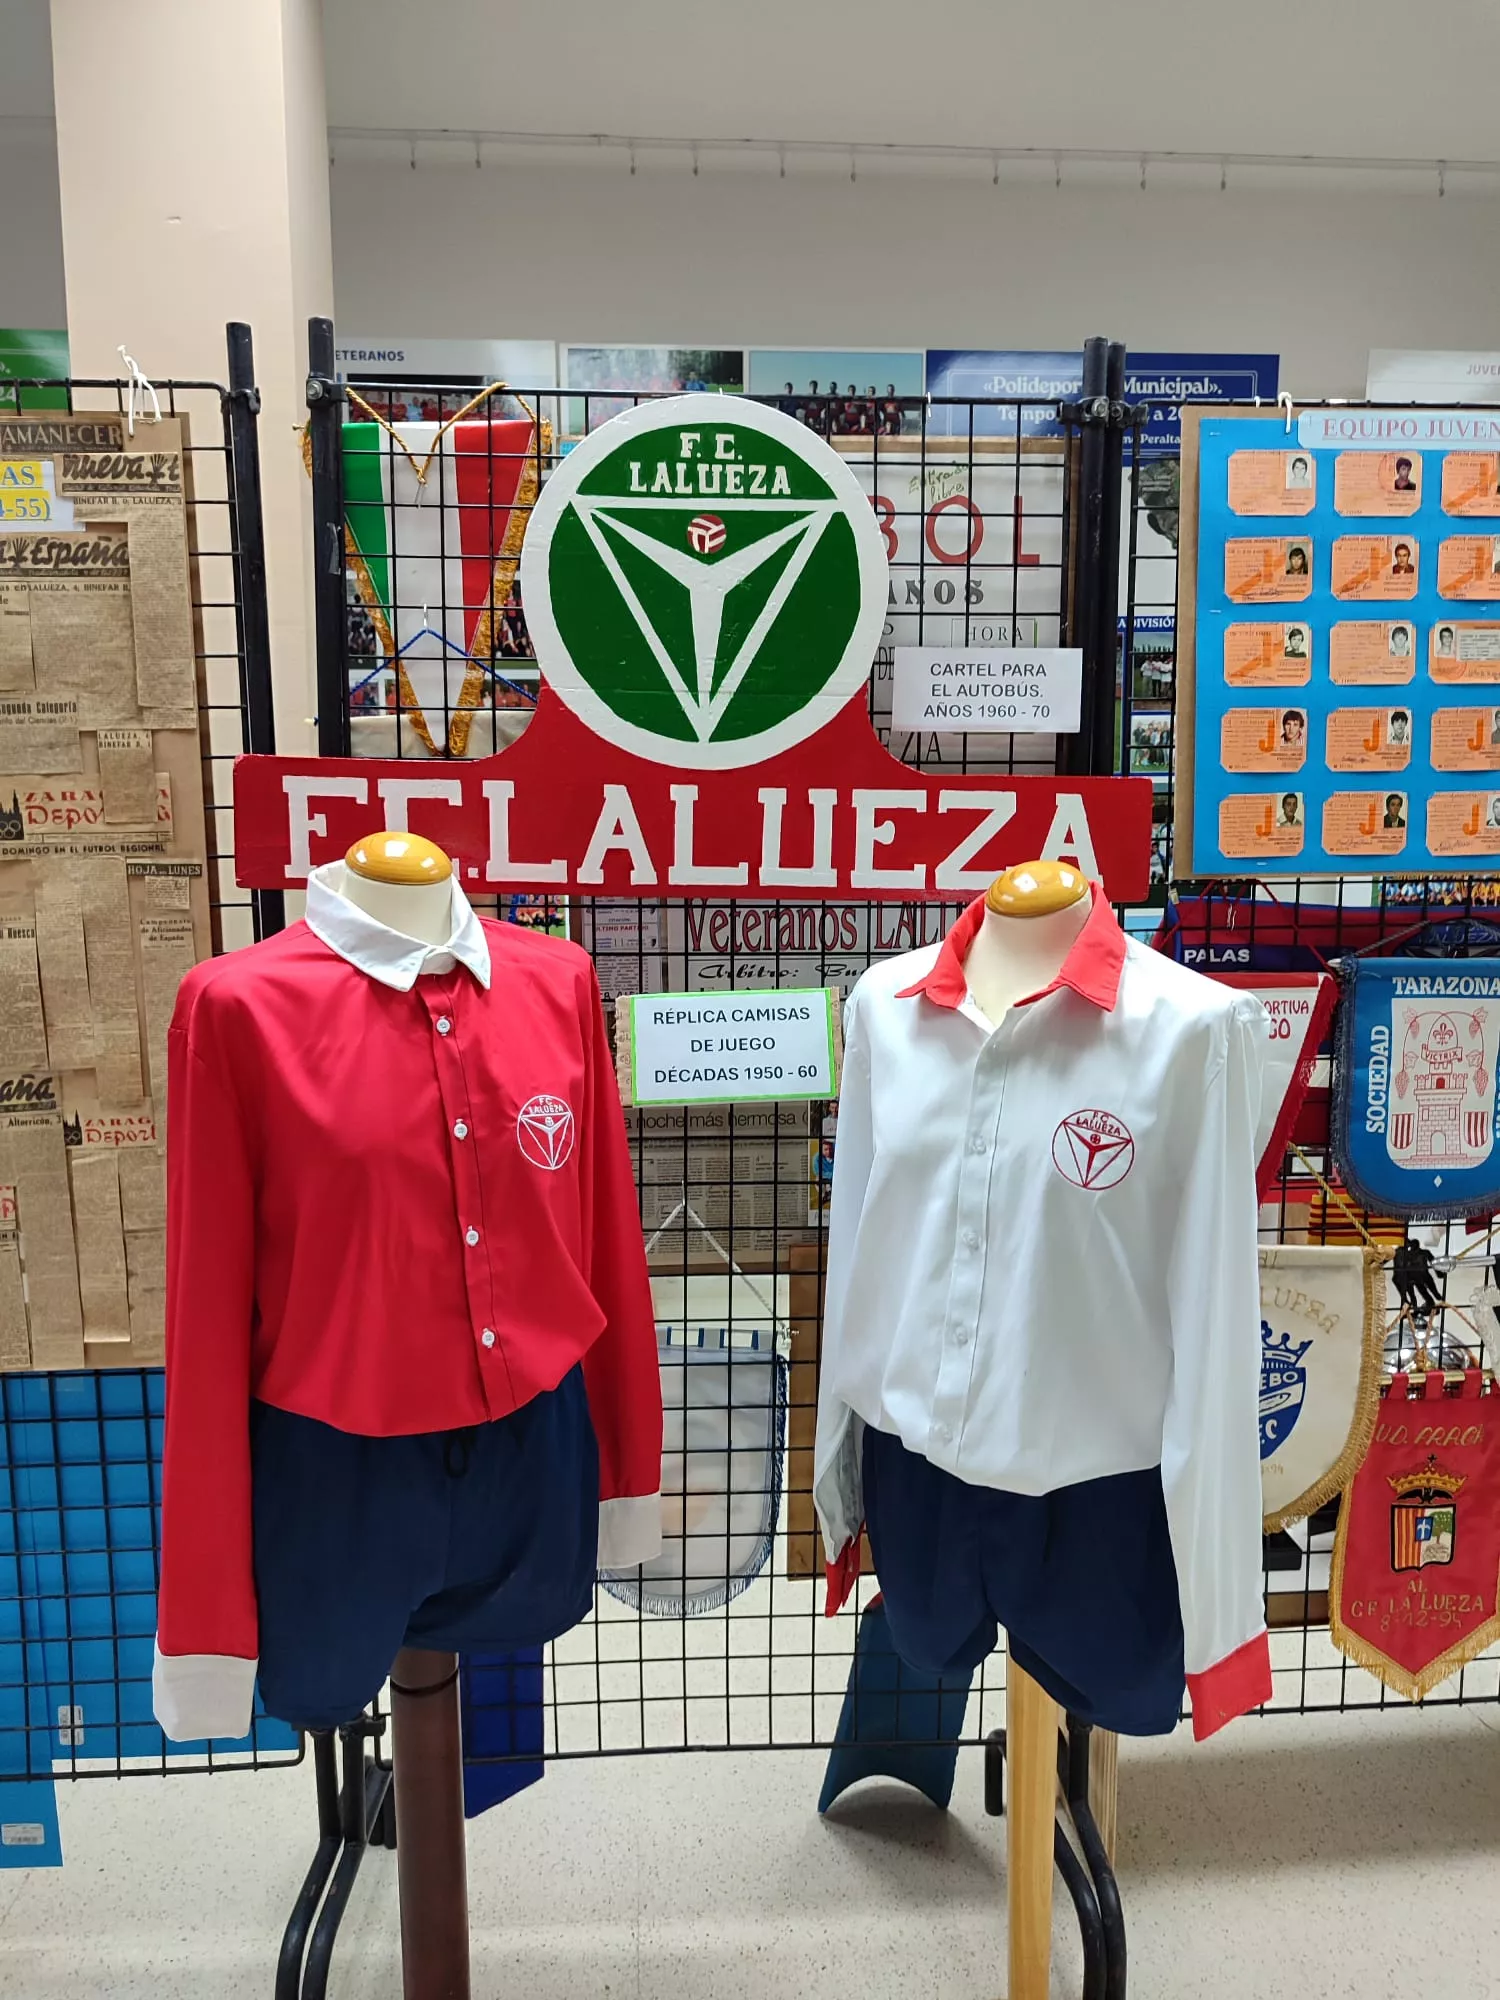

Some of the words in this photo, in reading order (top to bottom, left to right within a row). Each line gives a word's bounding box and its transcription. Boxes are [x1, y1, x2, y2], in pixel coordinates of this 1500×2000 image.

[1, 425, 123, 446] AMANECER
[1323, 418, 1418, 440] EQUIPO
[630, 461, 791, 495] LALUEZA
[930, 663, 996, 677] CARTEL
[1001, 663, 1047, 677] PARA
[931, 683, 952, 697] EL
[956, 681, 1044, 697] AUTOBÚS.
[923, 701, 973, 717] AÑOS
[978, 705, 1017, 718] 1960
[1032, 705, 1050, 718] 70
[168, 865, 201, 876] LUNES
[687, 899, 858, 953] Veteranos
[653, 1008, 728, 1025] RÉPLICA
[731, 1007, 810, 1023] CAMISAS
[691, 1039, 713, 1053] DE
[718, 1037, 776, 1051] JUEGO
[654, 1066, 739, 1083] DÉCADAS
[744, 1065, 783, 1080] 1950
[798, 1064, 818, 1078] 60
[1365, 1024, 1390, 1134] SOCIEDAD
[689, 1111, 723, 1128] más
[1076, 1116, 1121, 1136] LALUEZA
[1407, 1579, 1428, 1593] AL
